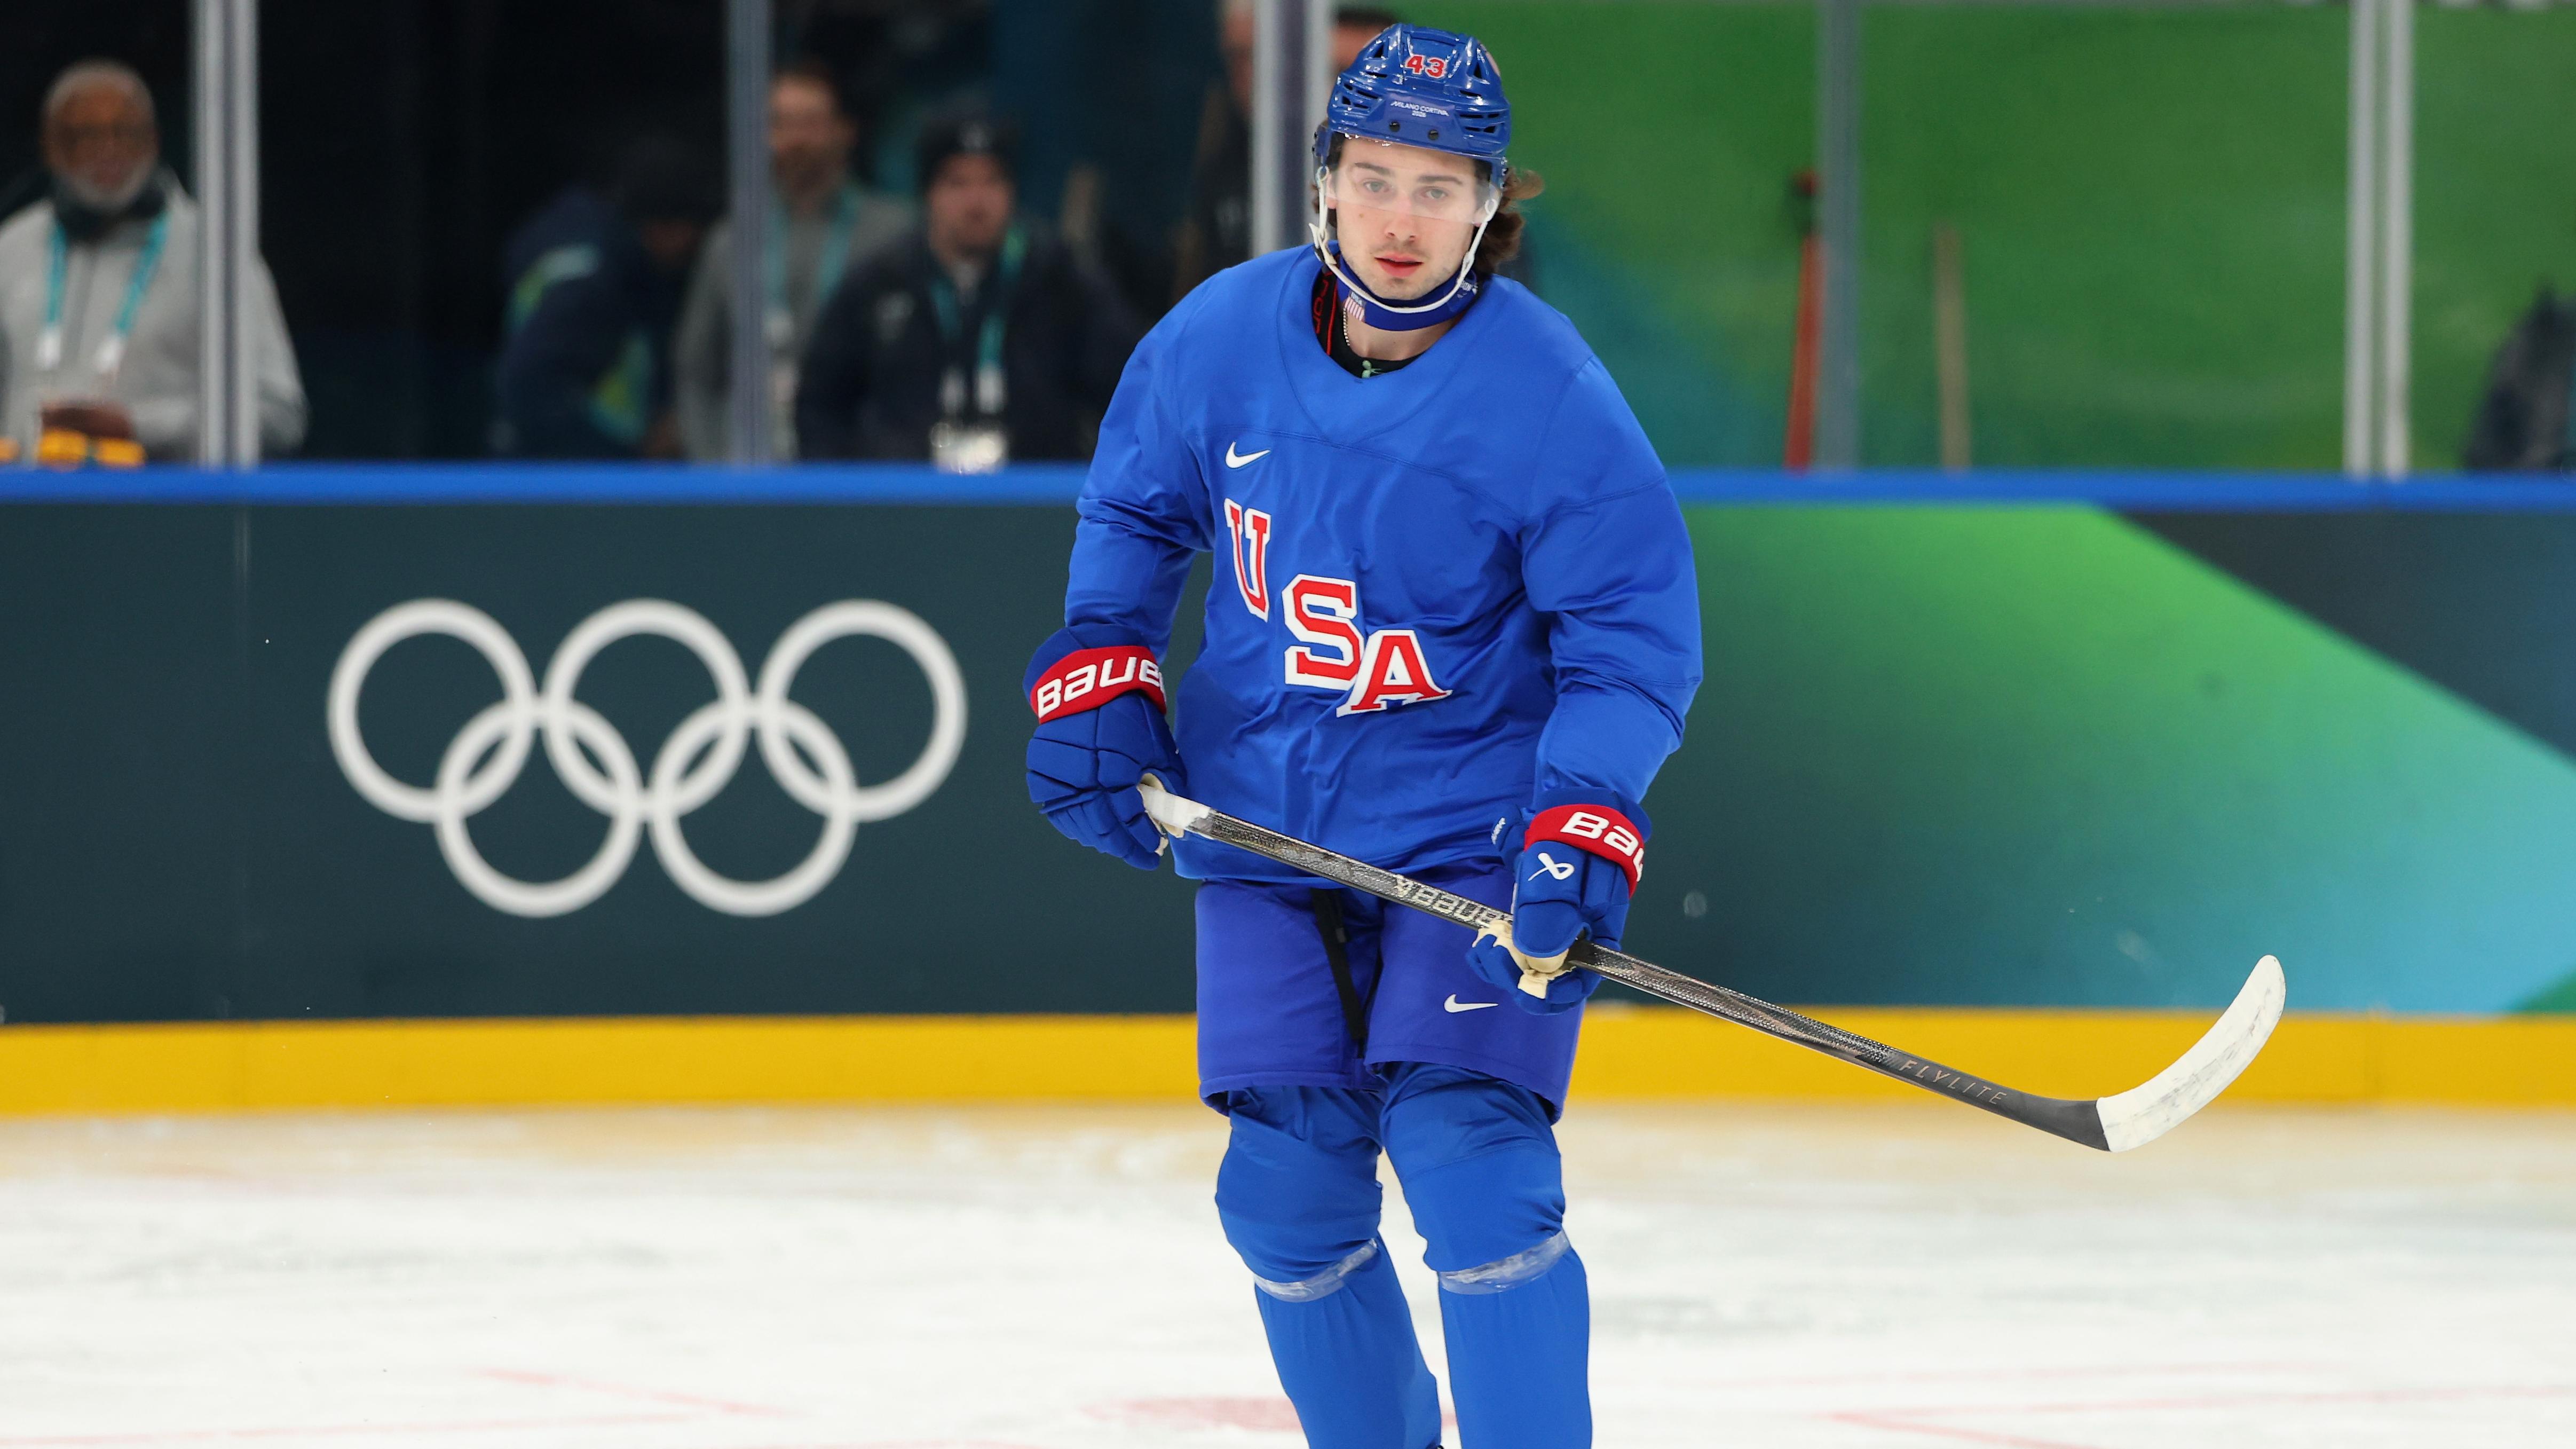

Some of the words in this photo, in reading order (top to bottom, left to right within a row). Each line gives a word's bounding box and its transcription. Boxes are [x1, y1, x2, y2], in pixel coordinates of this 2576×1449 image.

[1404, 54, 1447, 78] 43
[1390, 101, 1420, 111] MILANO
[1420, 106, 1450, 116] CORTINA
[1224, 498, 1453, 718] USA
[1899, 1059, 2007, 1105] FLYLITE
